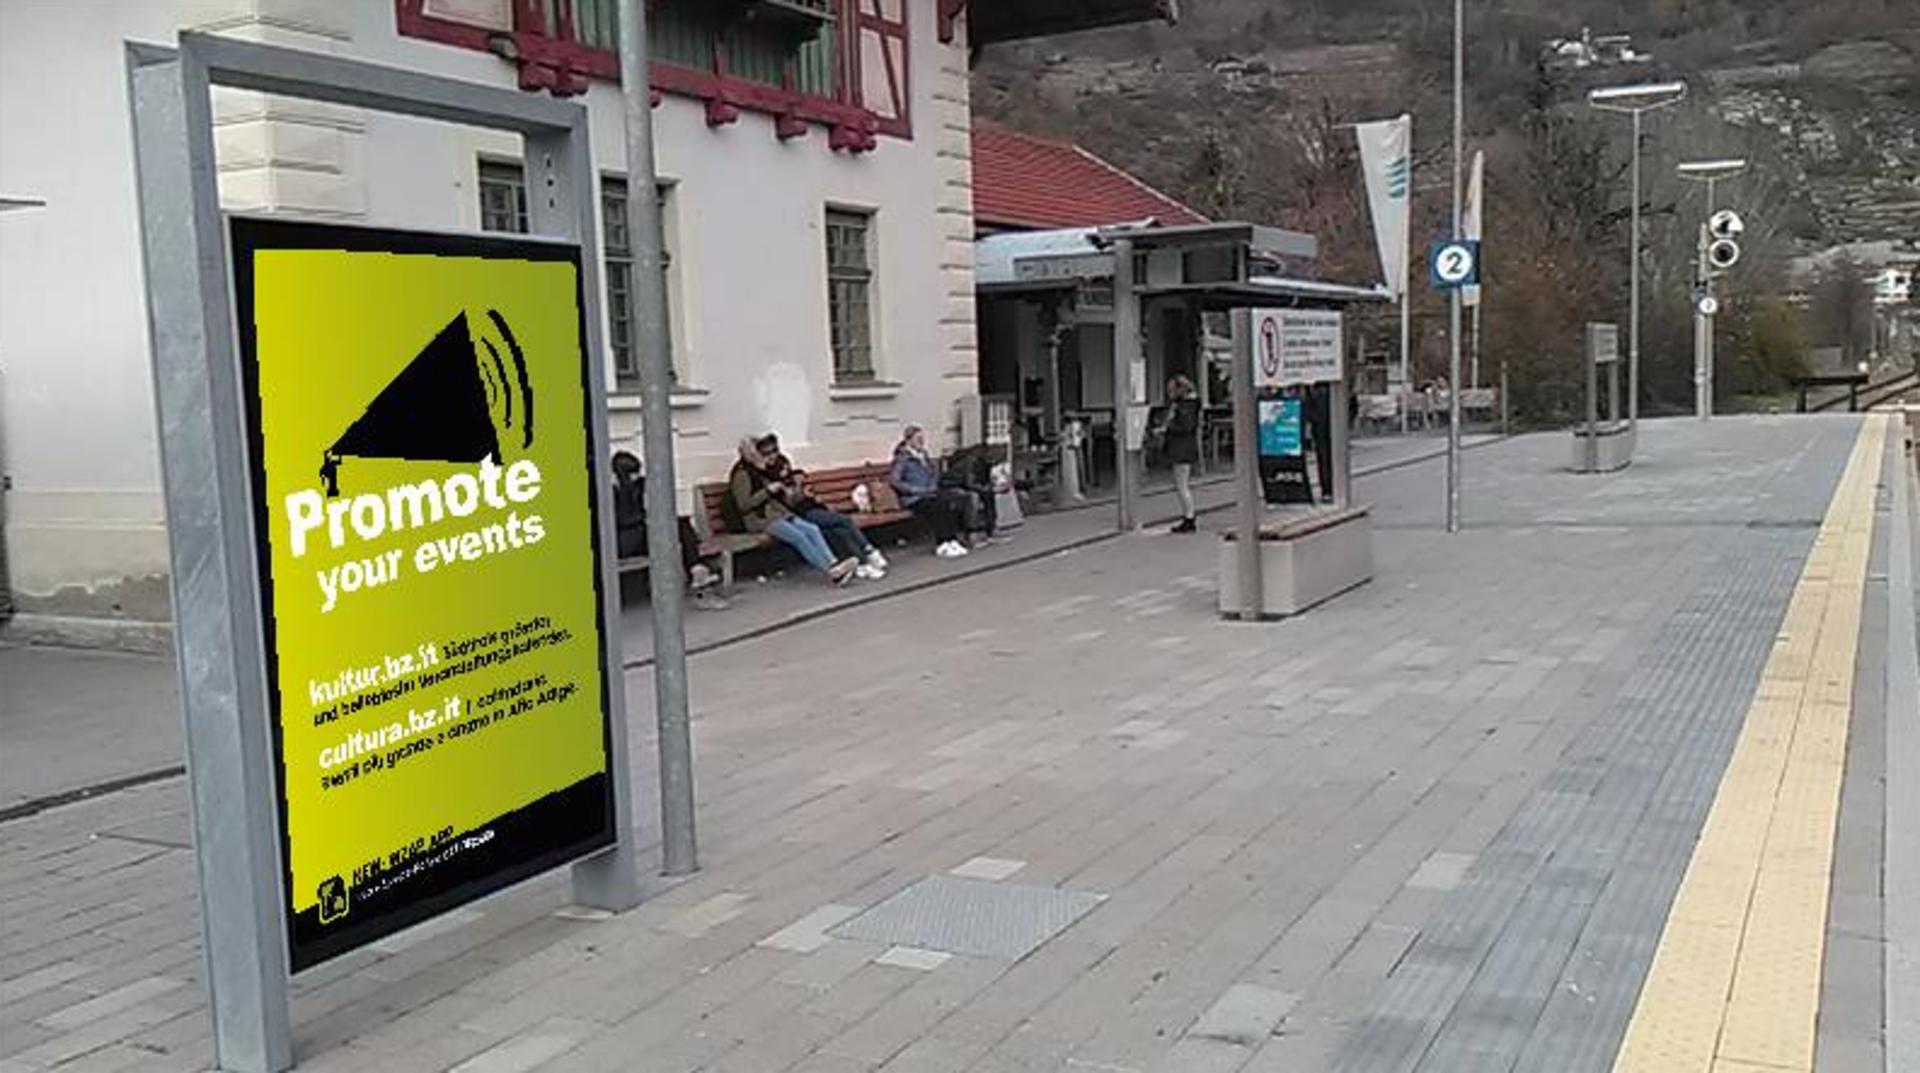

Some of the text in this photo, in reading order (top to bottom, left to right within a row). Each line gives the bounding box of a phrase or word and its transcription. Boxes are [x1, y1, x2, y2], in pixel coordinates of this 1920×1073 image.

[1446, 252, 1462, 274] 2
[285, 452, 542, 558] Promote
[317, 510, 546, 613] your events
[309, 642, 438, 707] kultur.bz.it
[319, 695, 460, 768] cultura.bz.it
